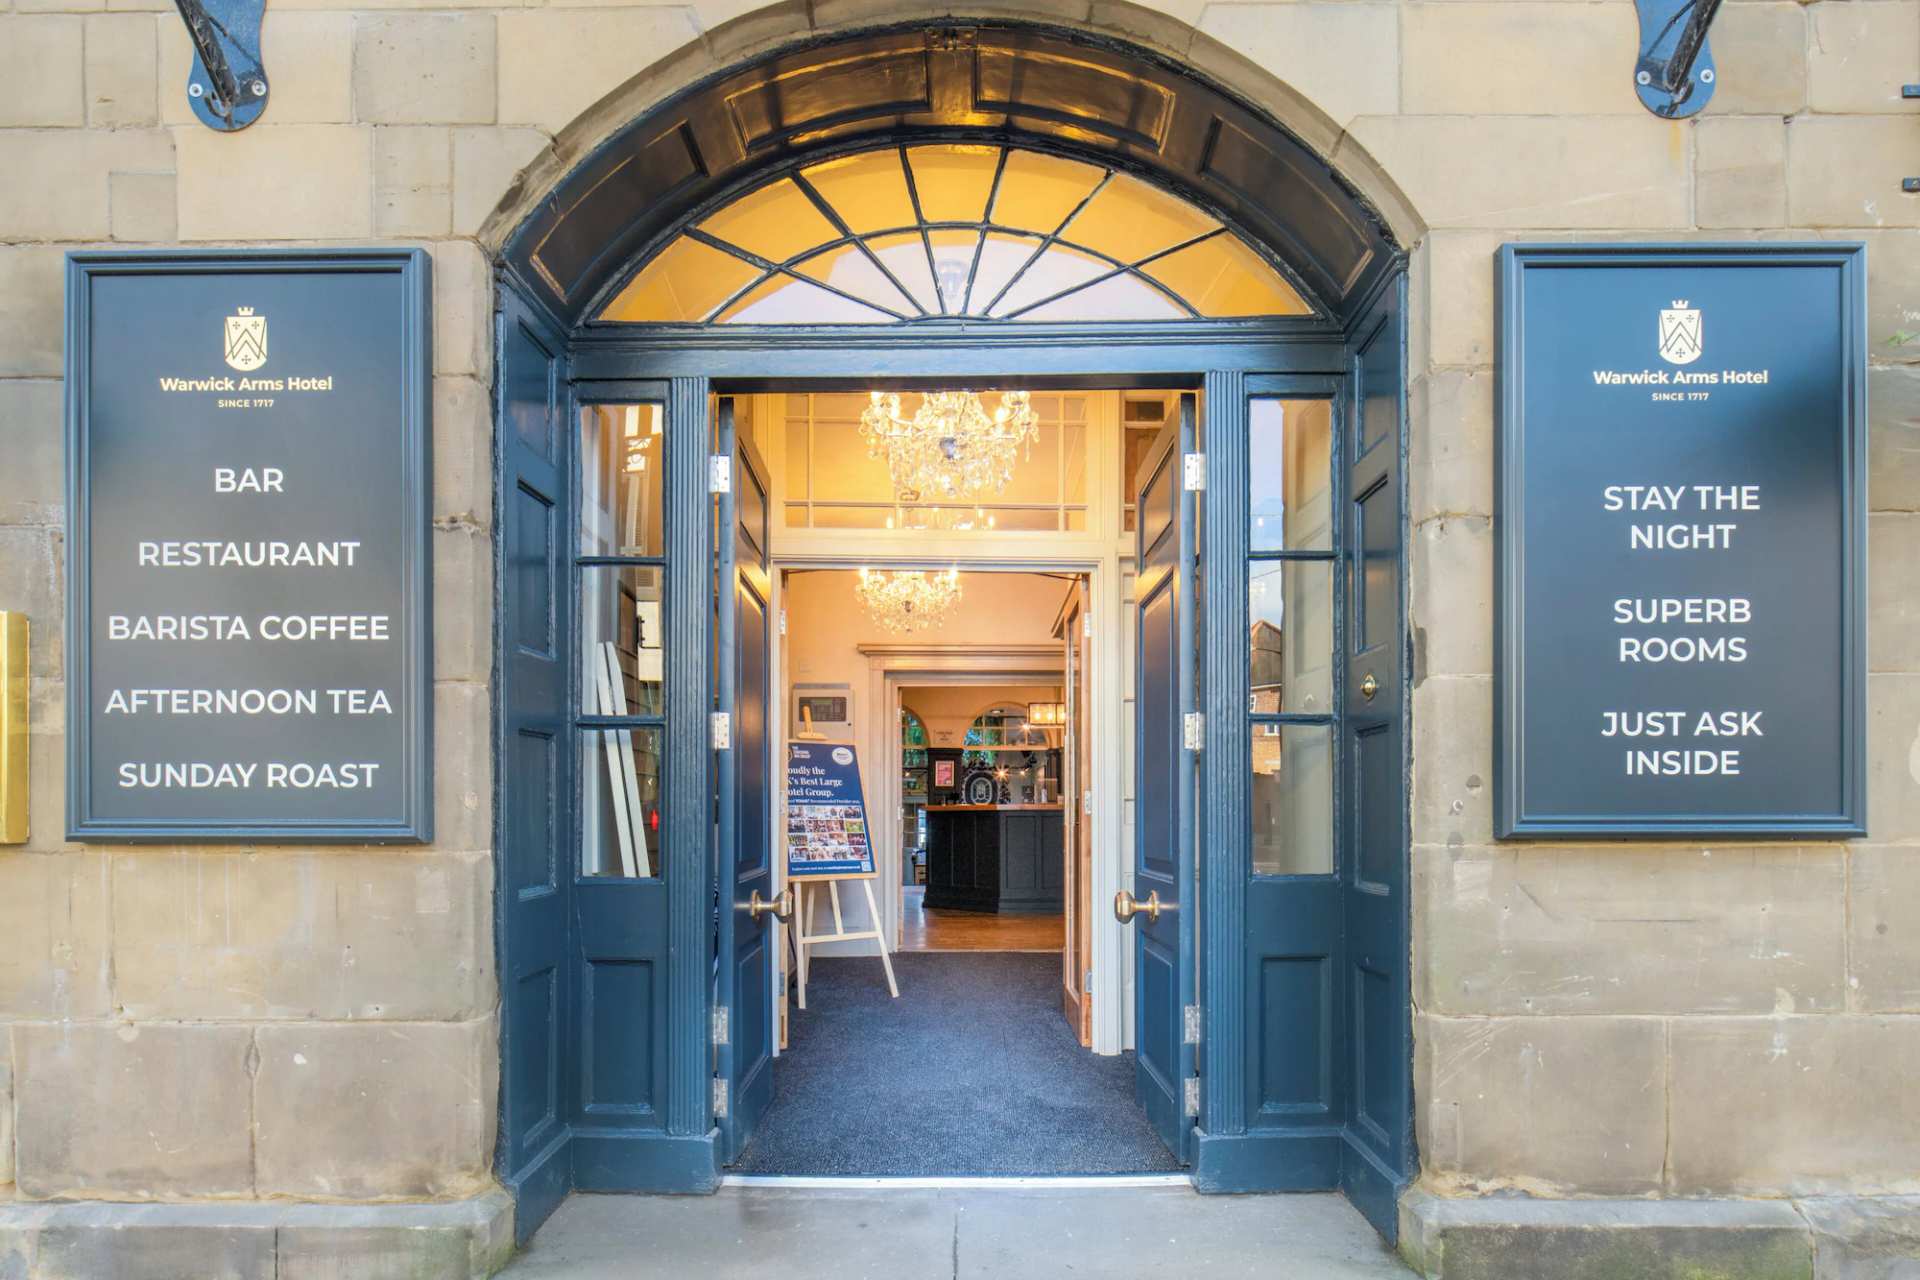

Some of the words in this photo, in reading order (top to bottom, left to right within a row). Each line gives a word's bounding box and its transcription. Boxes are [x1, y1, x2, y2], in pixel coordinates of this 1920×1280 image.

[160, 376, 235, 391] Warwick
[238, 377, 284, 391] Arms
[287, 376, 333, 391] Hotel
[1593, 369, 1669, 385] Warwick
[1672, 370, 1719, 384] Arms
[1722, 369, 1769, 385] Hotel
[218, 399, 250, 408] SINCE
[253, 399, 275, 408] 1717
[1652, 392, 1684, 401] SINCE
[1687, 392, 1709, 401] 1717
[214, 468, 284, 493] BAR
[1604, 486, 1687, 511] STAY
[1693, 486, 1761, 511] THE
[1630, 524, 1736, 549] NIGHT
[138, 542, 361, 567] RESTAURANT
[1613, 598, 1752, 623] SUPERB
[109, 616, 250, 641] BARISTA
[259, 616, 390, 641] COFFEE
[1619, 637, 1748, 662] ROOMS
[104, 689, 317, 714] AFTERNOON
[327, 689, 393, 714] TEA
[1601, 711, 1686, 736] JUST
[1693, 711, 1763, 736] ASK
[812, 766, 825, 775] the
[1626, 750, 1740, 775] INSIDE
[118, 763, 257, 788] SUNDAY
[266, 763, 379, 788] ROAST
[800, 777, 818, 786] Best
[819, 778, 843, 788] Large
[805, 788, 834, 798] Group.
